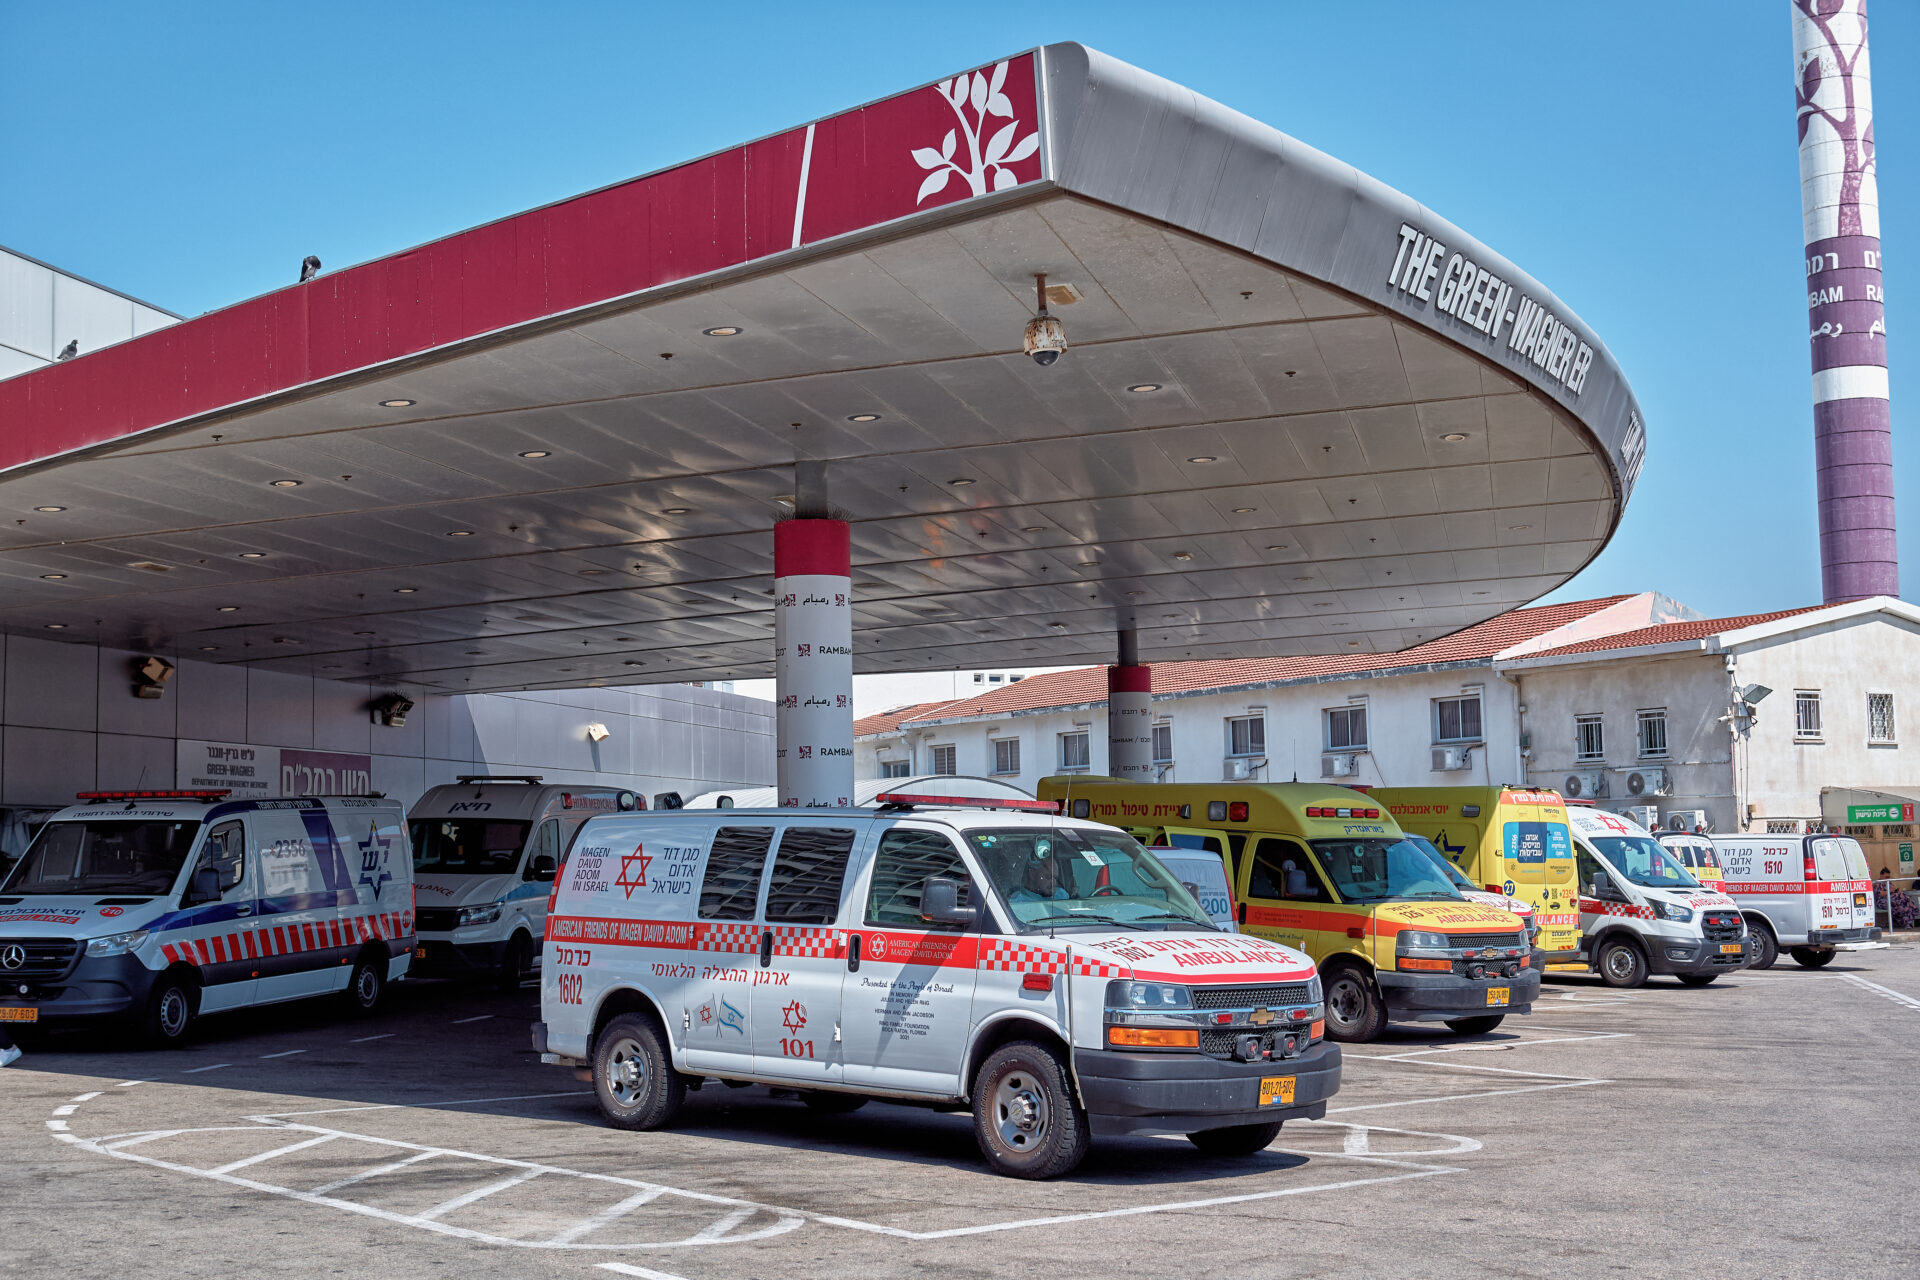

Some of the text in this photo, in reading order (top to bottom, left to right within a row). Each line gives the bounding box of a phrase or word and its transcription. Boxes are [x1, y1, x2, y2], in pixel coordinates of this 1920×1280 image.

[1388, 224, 1594, 396] THE GREEN-WAGNER ER
[803, 593, 829, 606] رمبام
[819, 646, 852, 656] RAMBAM
[804, 695, 830, 708] رمبام
[820, 747, 852, 756] RAMBAM
[207, 763, 255, 778] GREEN-WAGNER
[192, 778, 269, 790] DEPARTMENT OF EMERGENCY MEDICINE
[342, 769, 369, 796] מיון
[448, 801, 492, 814] חיאן
[1091, 800, 1182, 818] ניידת טיפול נמרץ
[1390, 803, 1449, 815] יוסי אמבולנס
[1344, 825, 1385, 835] פאראמדיק
[580, 847, 611, 858] MAGEN
[663, 847, 700, 863] מגן דוד
[1722, 848, 1753, 857] מגן דוד
[1762, 847, 1788, 856] כרמל
[577, 858, 603, 869] DAVID
[1730, 857, 1752, 867] אדום
[1764, 861, 1783, 875] 1510
[575, 869, 601, 880] ADOM
[669, 864, 696, 878] אדום
[1722, 866, 1751, 876] בישרא
[572, 881, 609, 892] IN ISRAEL
[651, 878, 691, 895] בישראל
[1505, 883, 1514, 894] 27
[1744, 884, 1751, 893] OF
[1751, 884, 1769, 893] MAGEN
[1769, 883, 1785, 893] DAVID
[1786, 883, 1802, 893] ADOM
[1830, 881, 1867, 893] AMBULANCE
[1822, 906, 1833, 918] 1510
[1436, 914, 1512, 924] AMBULANCE
[553, 920, 688, 944] AMERICAN FRIENDS OF MAGEN DAVID ADOM
[889, 939, 957, 951] AMERICAN FRIENDS OF
[1089, 936, 1134, 949] כרמל
[1140, 938, 1277, 952] מגן דוד אדום
[556, 945, 591, 967] כרמל
[890, 948, 952, 961] MAGEN DAVID ADOM
[1112, 946, 1155, 962] 1602
[1172, 950, 1298, 968] AMBULANCE
[651, 962, 790, 987] ארגון ההצלה הלאומי
[558, 973, 582, 1006] 1602
[861, 977, 953, 995] Presented to the People of Israel
[912, 1011, 934, 1019] JACOBSON
[904, 1023, 930, 1031] FOUNDATION
[779, 1038, 815, 1060] 101
